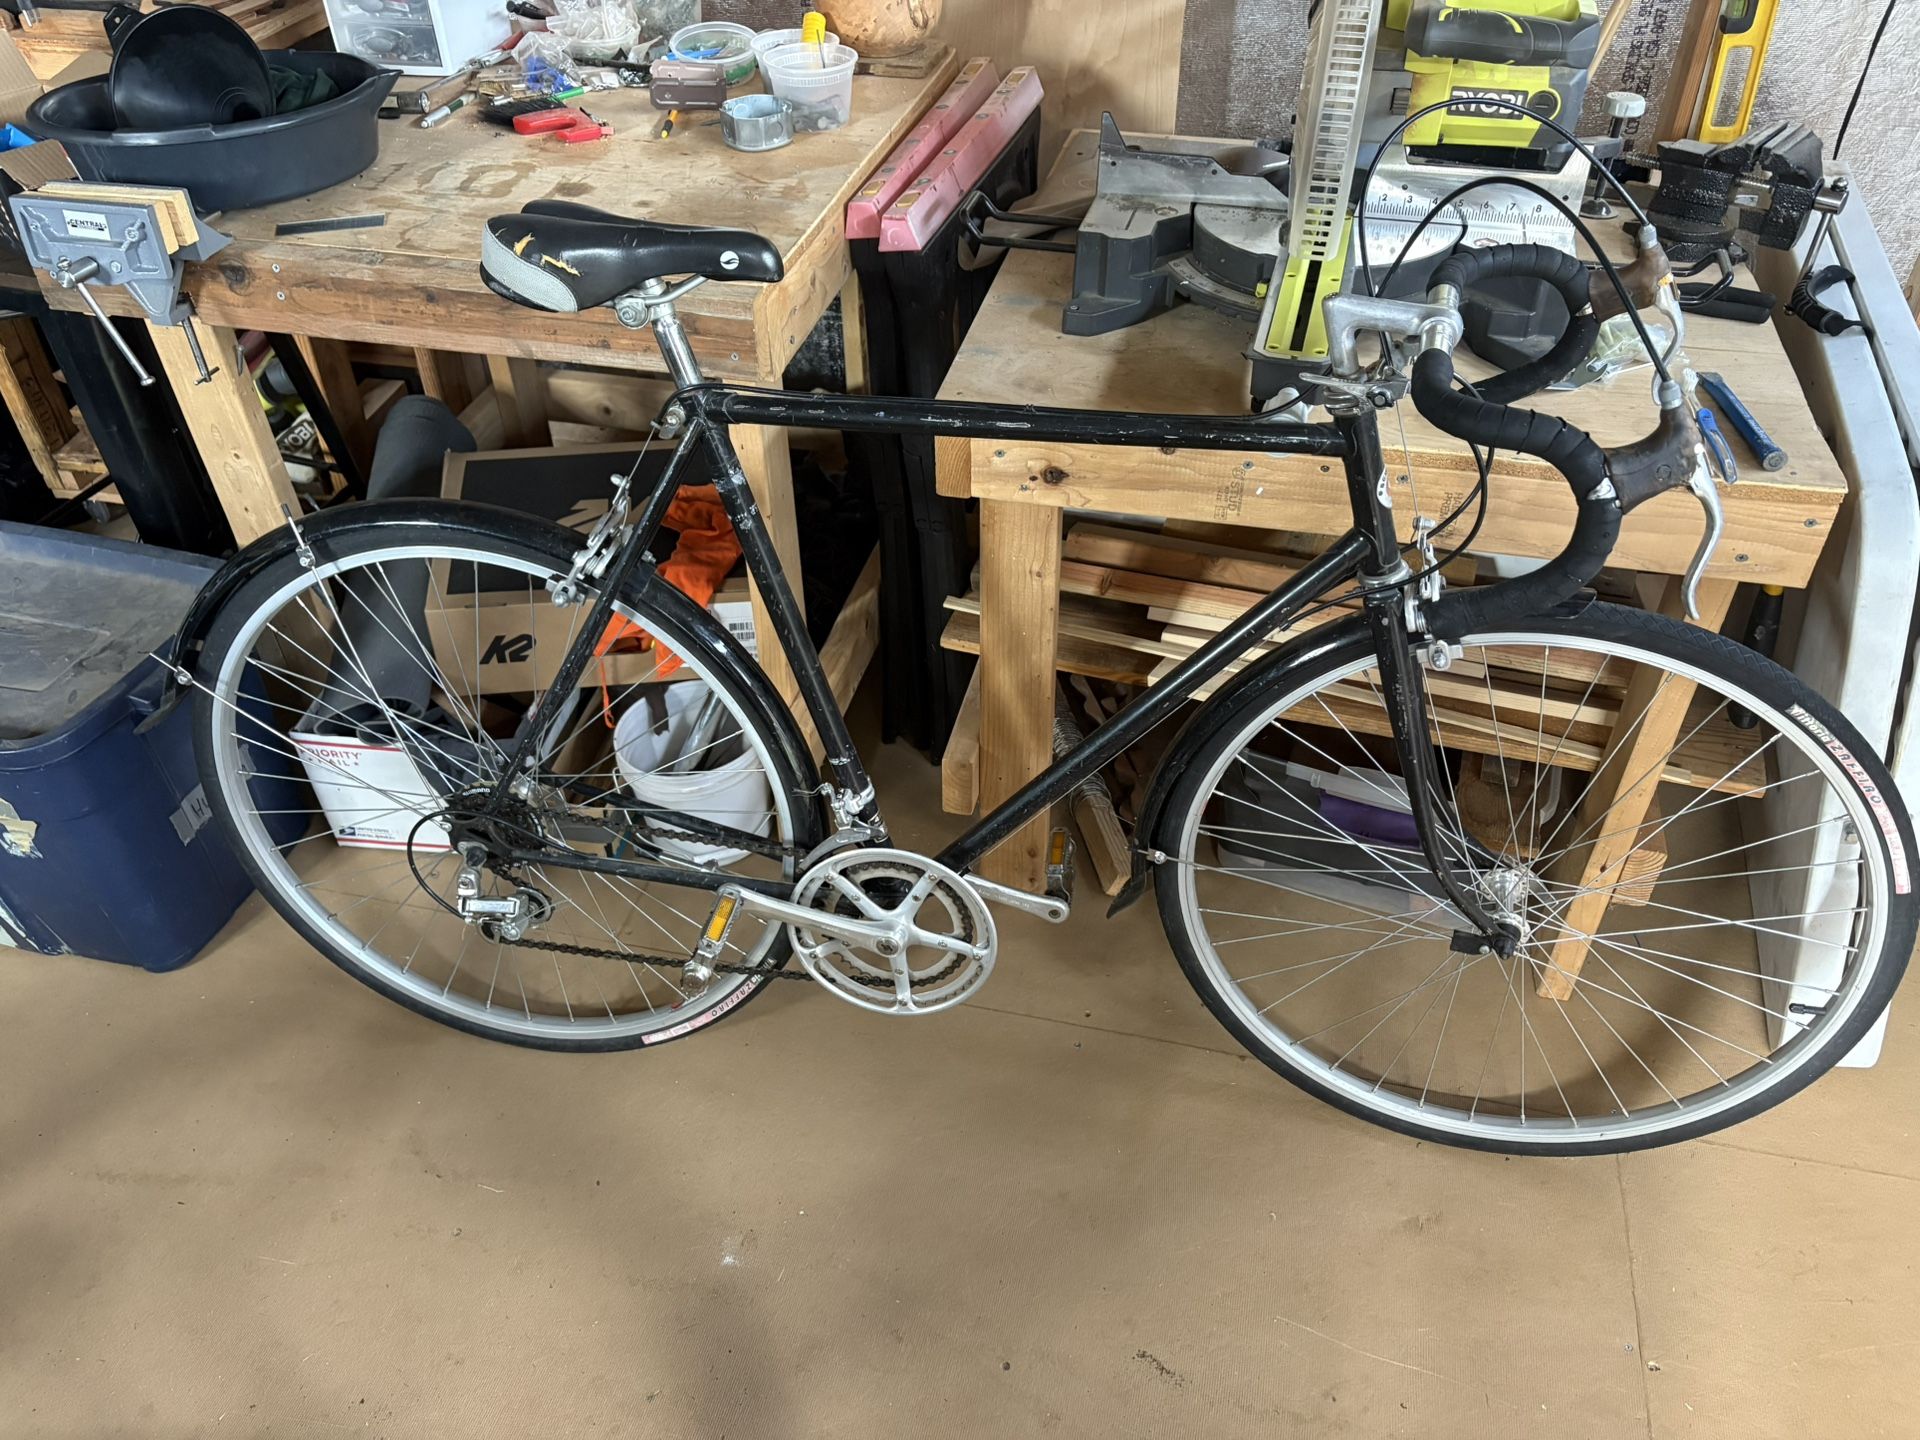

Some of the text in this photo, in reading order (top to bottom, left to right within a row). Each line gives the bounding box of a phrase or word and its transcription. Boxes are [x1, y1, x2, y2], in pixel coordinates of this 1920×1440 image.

[1450, 90, 1525, 116] RYOBI
[1382, 193, 1542, 213] 2 3 4 5 6 7 8
[69, 218, 104, 229] CENTRAL
[1228, 480, 1240, 511] STUD
[480, 633, 537, 665] K2
[1828, 737, 1883, 805] ZAFFIRO
[710, 980, 754, 1018] ZAFFIRO
